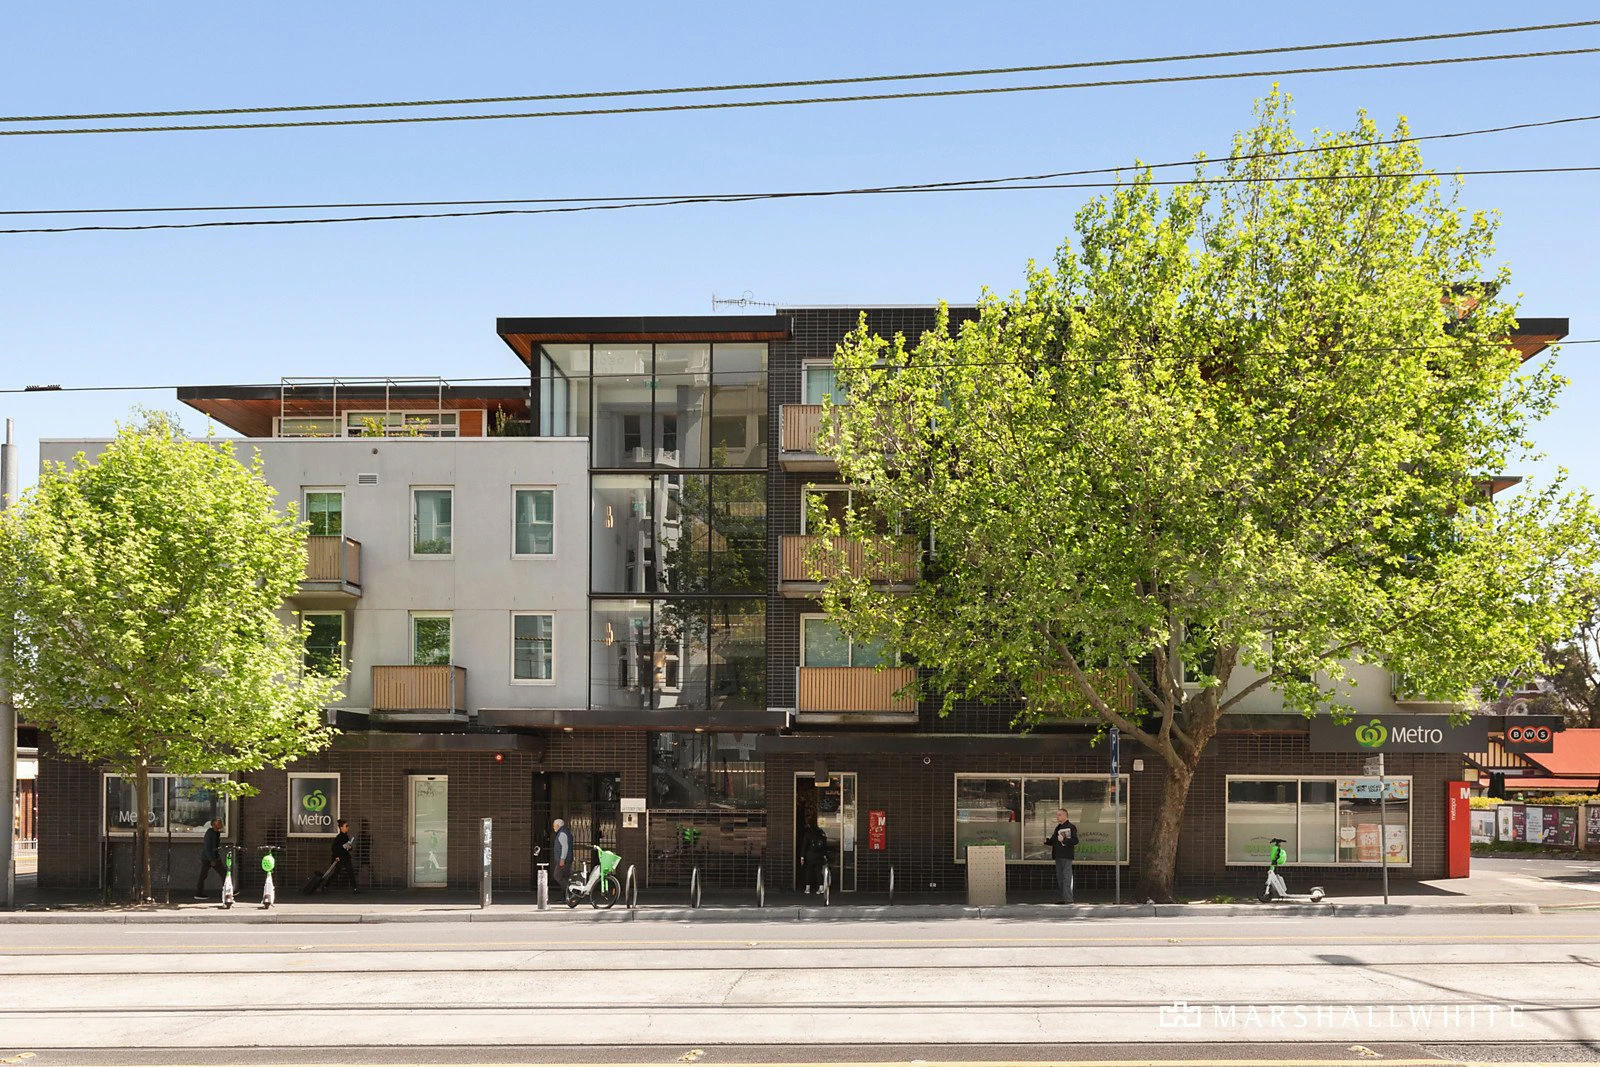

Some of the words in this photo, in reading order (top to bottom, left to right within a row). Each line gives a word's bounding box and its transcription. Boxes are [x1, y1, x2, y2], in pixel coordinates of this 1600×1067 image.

[1391, 725, 1443, 744] Metro
[1511, 730, 1548, 739] BWS
[1460, 787, 1471, 800] M
[119, 810, 156, 823] Meo
[297, 813, 332, 826] Metro
